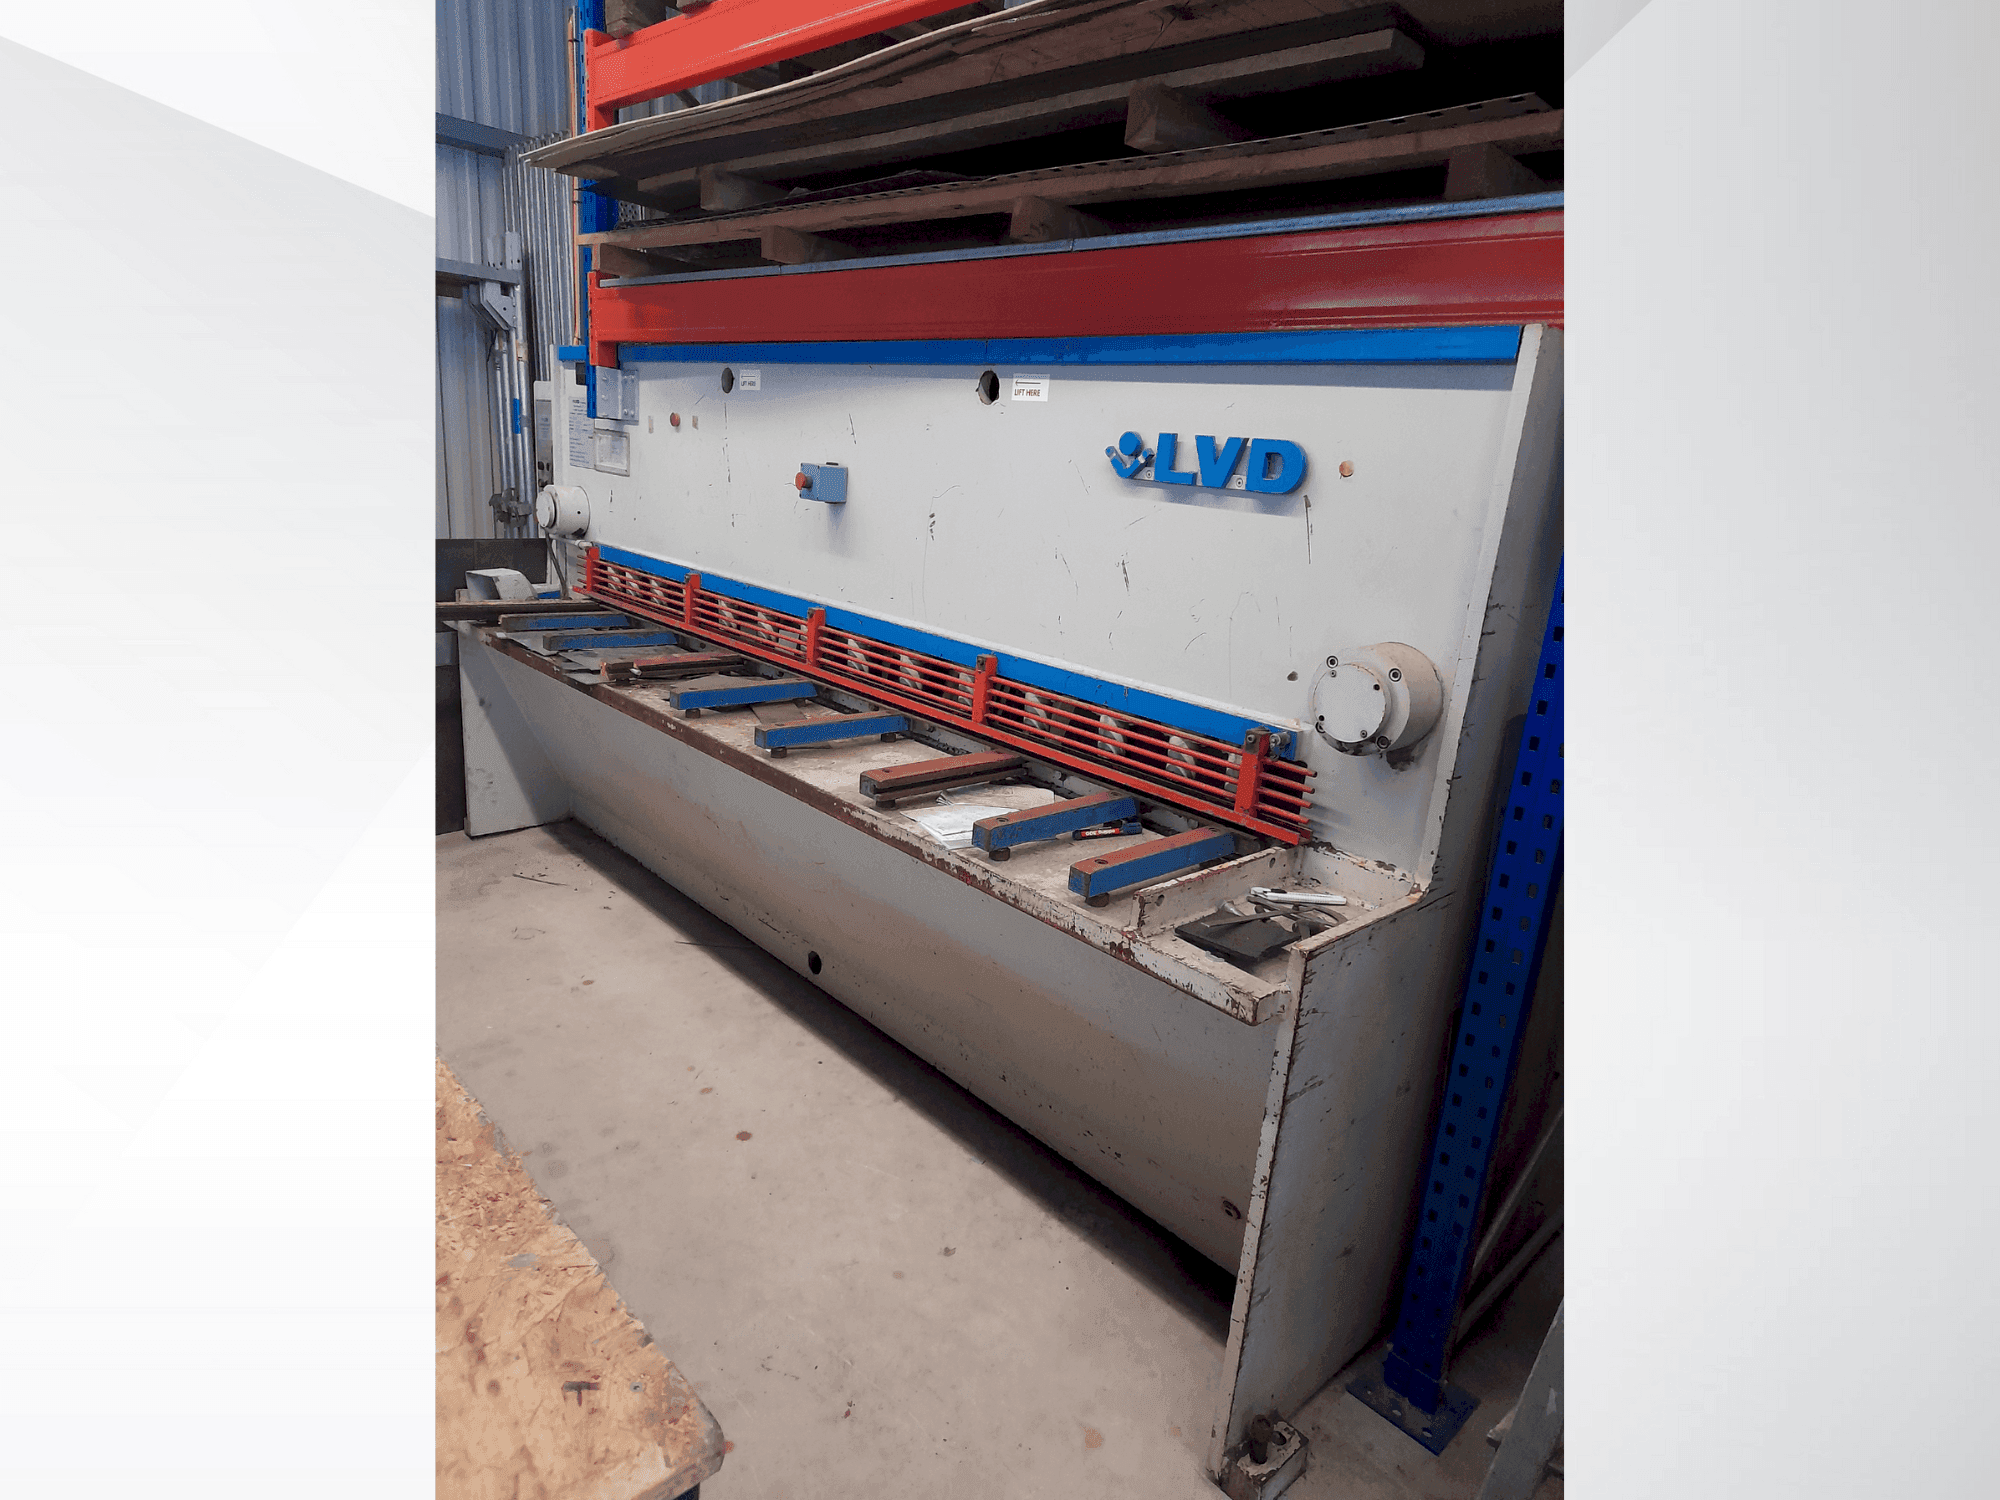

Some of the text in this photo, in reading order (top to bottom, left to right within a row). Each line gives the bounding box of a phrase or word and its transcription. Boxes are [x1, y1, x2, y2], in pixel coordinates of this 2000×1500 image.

[1014, 388, 1041, 397] LIFT HERE
[1154, 432, 1308, 495] LVD
